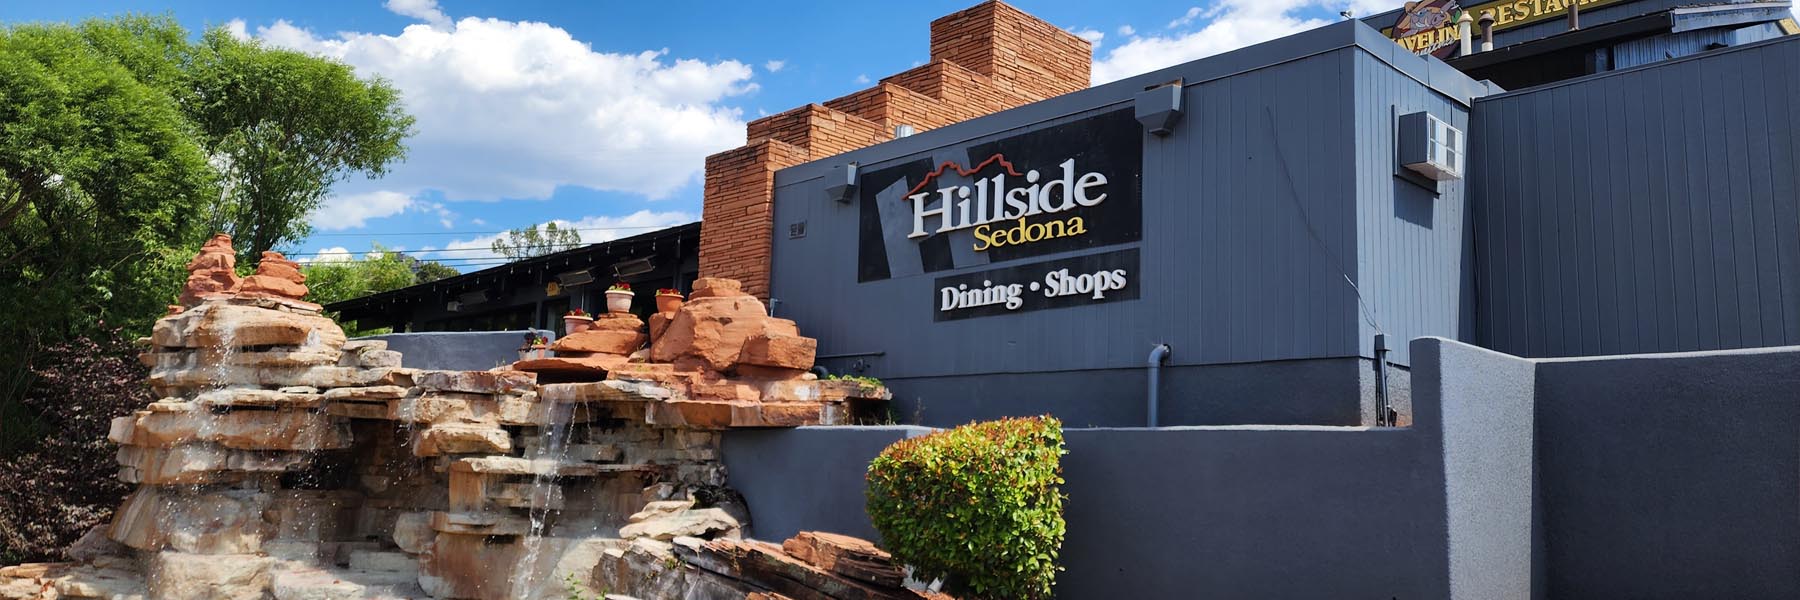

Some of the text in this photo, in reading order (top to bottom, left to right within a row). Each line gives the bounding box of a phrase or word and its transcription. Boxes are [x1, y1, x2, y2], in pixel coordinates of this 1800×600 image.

[1392, 25, 1462, 52] AVELIN
[907, 158, 1108, 239] Hillside
[972, 216, 1087, 251] Sedona
[940, 268, 1127, 312] Dining Shops
